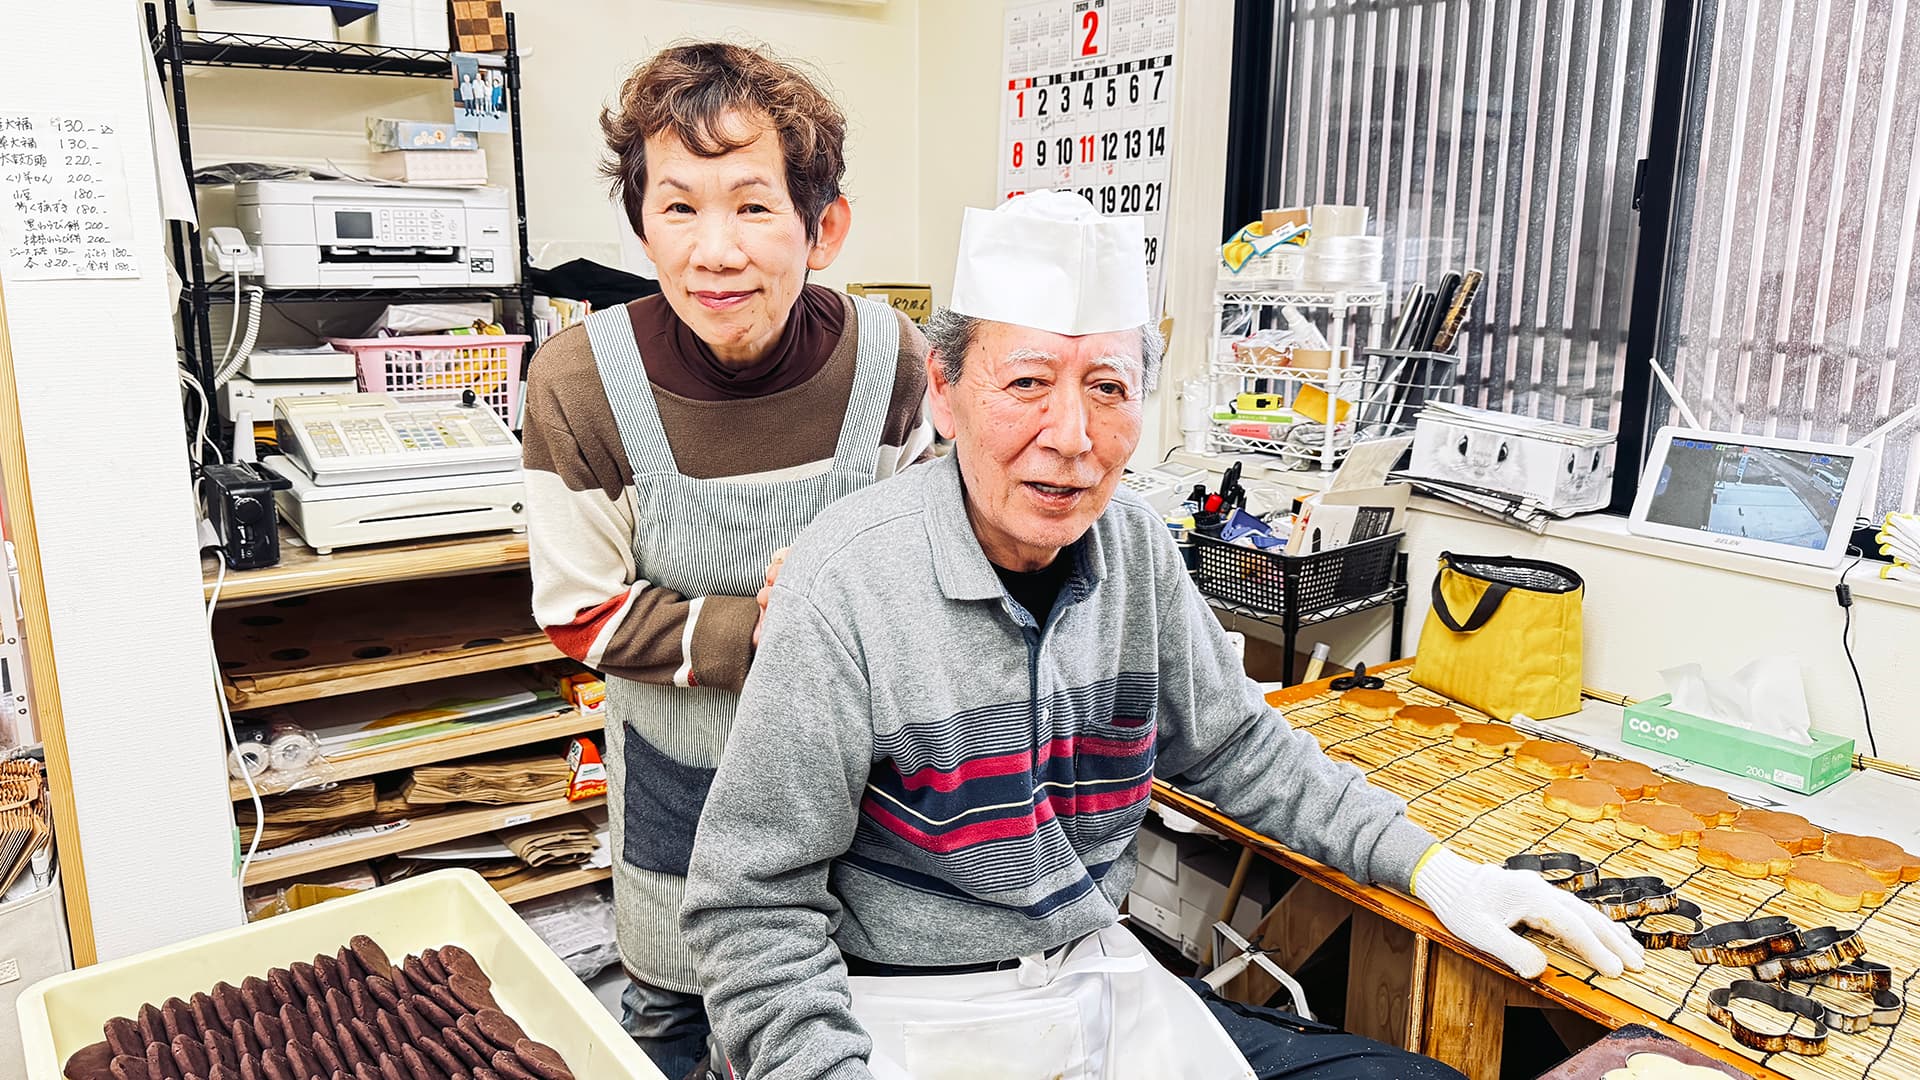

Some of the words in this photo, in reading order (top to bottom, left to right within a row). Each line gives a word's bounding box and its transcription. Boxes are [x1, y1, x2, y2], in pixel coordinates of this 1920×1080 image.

[1081, 10, 1099, 57] 2
[1016, 91, 1024, 118] 1
[1037, 88, 1048, 116] 2
[1060, 85, 1071, 113] 3
[1083, 82, 1093, 110] 4
[1106, 78, 1116, 107] 5
[1129, 74, 1139, 104] 6
[1153, 70, 1165, 101] 7
[1012, 141, 1024, 168] 8
[1036, 140, 1047, 167] 9
[1055, 137, 1073, 165] 10
[1079, 134, 1095, 164] 11
[1101, 132, 1118, 161] 12
[1124, 129, 1142, 159] 13
[1147, 126, 1166, 156] 14
[1099, 186, 1116, 214] 19
[1120, 184, 1141, 213] 20
[1144, 182, 1163, 212] 21
